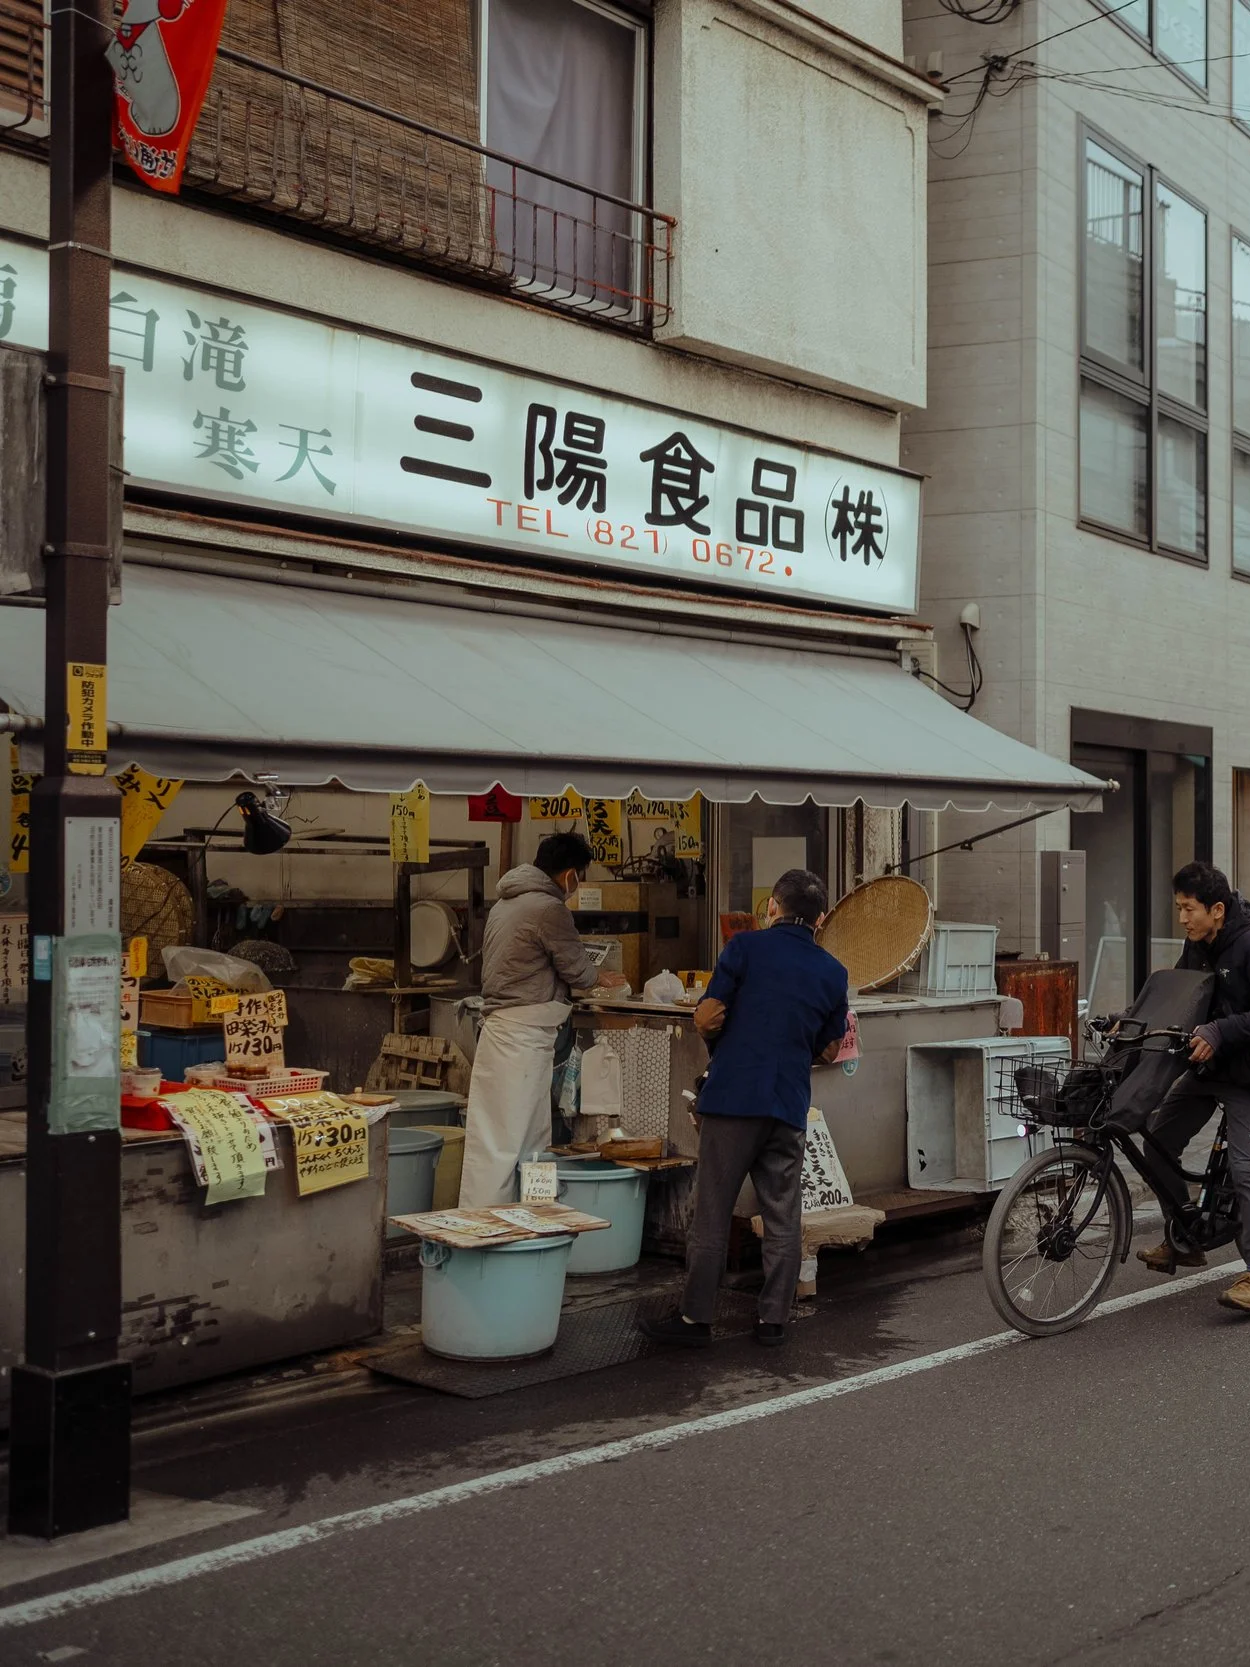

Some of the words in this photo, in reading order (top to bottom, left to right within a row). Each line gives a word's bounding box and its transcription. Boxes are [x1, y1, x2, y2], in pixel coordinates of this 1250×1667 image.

[109, 290, 249, 393] 白滝
[193, 406, 338, 497] 寒天
[486, 498, 569, 540] TEL
[585, 517, 669, 556] (821)
[81, 680, 95, 748] 防犯カメラ作動中
[391, 803, 415, 819] 150円
[819, 1189, 850, 1206] 200円
